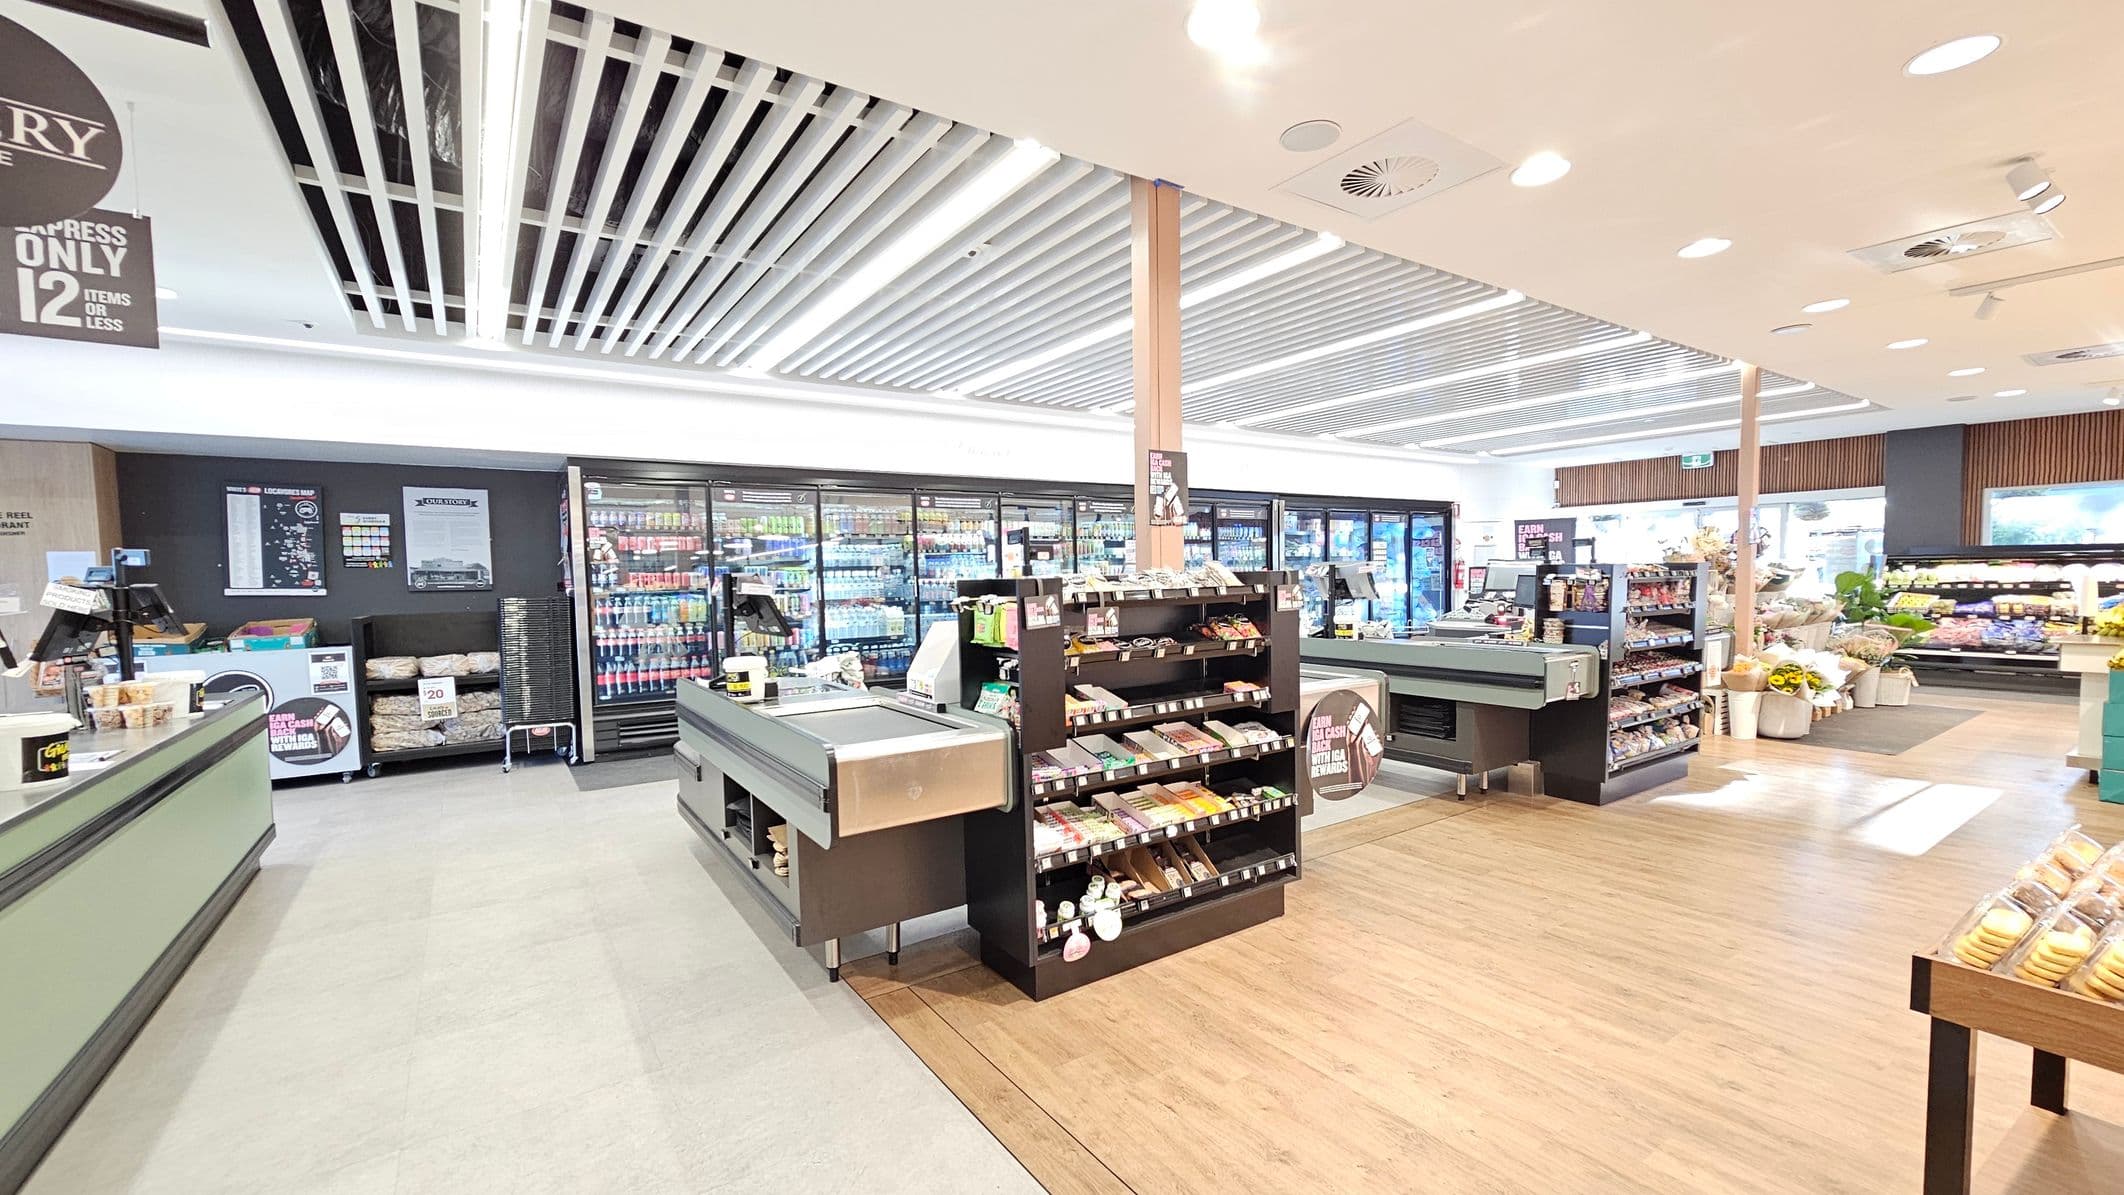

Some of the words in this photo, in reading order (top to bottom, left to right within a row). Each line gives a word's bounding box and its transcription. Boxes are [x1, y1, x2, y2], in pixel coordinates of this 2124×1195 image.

[0, 105, 105, 160] RY
[14, 219, 127, 246] PRESS
[15, 233, 128, 277] ONLY
[16, 267, 82, 327] 12
[84, 288, 132, 306] ITEMS
[85, 302, 107, 316] OR
[86, 316, 123, 331] LESS
[6, 511, 34, 519] REEL
[0, 521, 31, 529] RANT
[1518, 524, 1544, 534] EARN
[43, 598, 65, 609] SOLD
[46, 591, 90, 606] PRODUCTS
[269, 713, 295, 722] EARN
[269, 720, 287, 730] IGA
[288, 719, 314, 728] CASH
[1312, 715, 1332, 729] EARN
[269, 728, 296, 737] BACK
[270, 734, 297, 744] WITH
[297, 733, 314, 742] IGA
[1312, 728, 1325, 741] IGA
[1325, 725, 1347, 739] CASH
[270, 741, 318, 752] REWARDS
[1312, 740, 1332, 753] BACK
[1311, 751, 1331, 766] WITH
[1331, 749, 1346, 762] IGA
[1311, 761, 1348, 778] REWARDS
